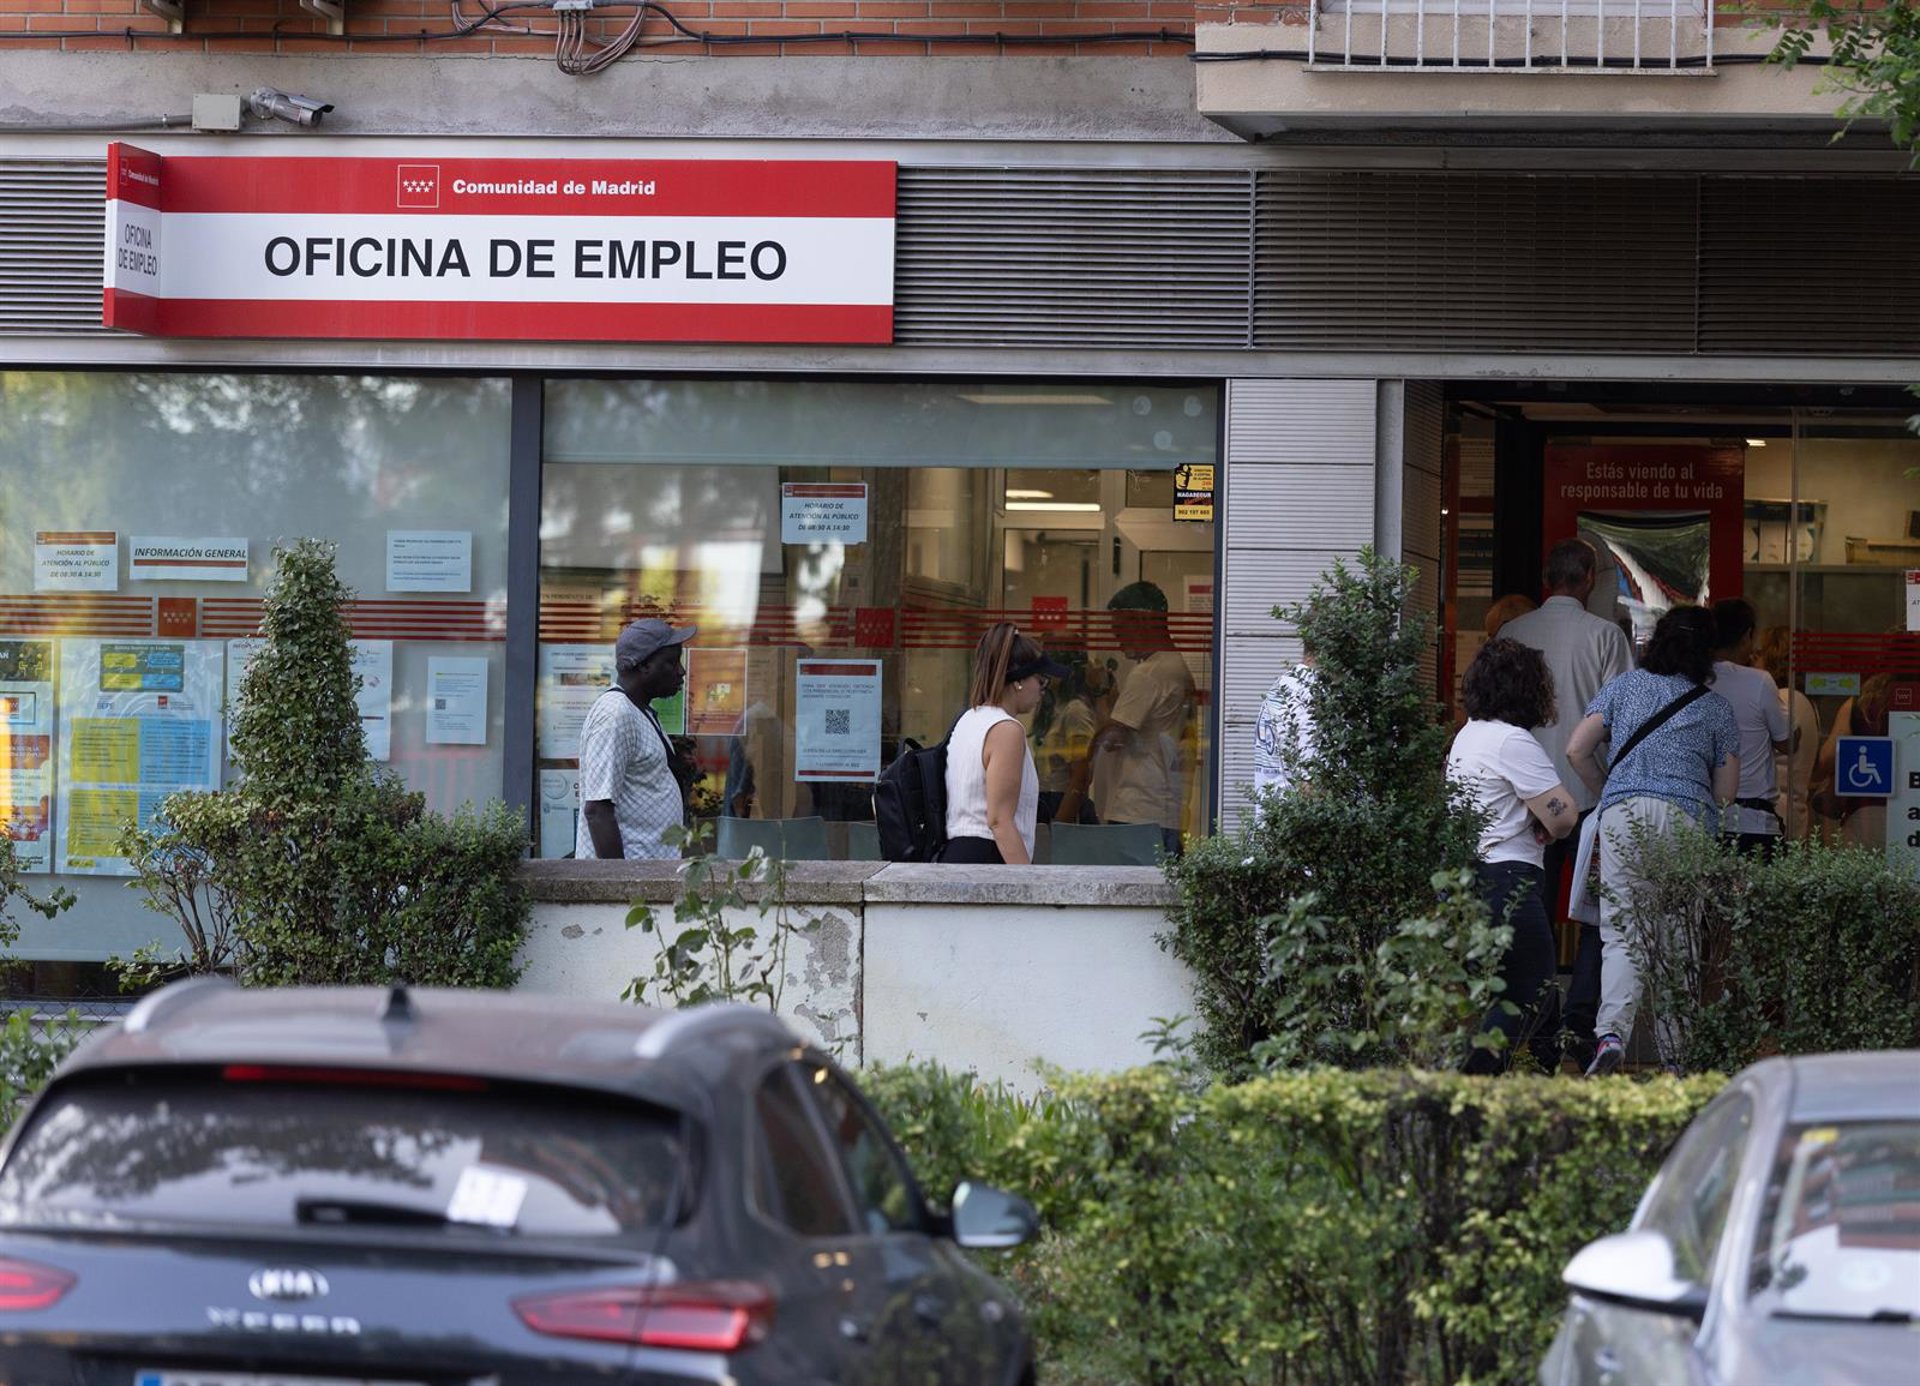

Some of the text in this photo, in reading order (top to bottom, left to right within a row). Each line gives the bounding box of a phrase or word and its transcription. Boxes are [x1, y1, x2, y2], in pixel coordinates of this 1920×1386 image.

[452, 180, 656, 196] Comunidad de Madrid
[124, 223, 152, 249] OFICINA
[118, 247, 158, 277] DE EMPLEO
[264, 236, 787, 281] OFICINA DE EMPLEO
[1586, 462, 1694, 479] Estás viendo al
[1561, 481, 1723, 503] responsable de tu vida
[831, 512, 860, 520] PÚBLICO
[56, 549, 85, 557] HORARIO
[134, 547, 247, 559] INFORMACIÓN GENERAL
[261, 1269, 315, 1296] KIA
